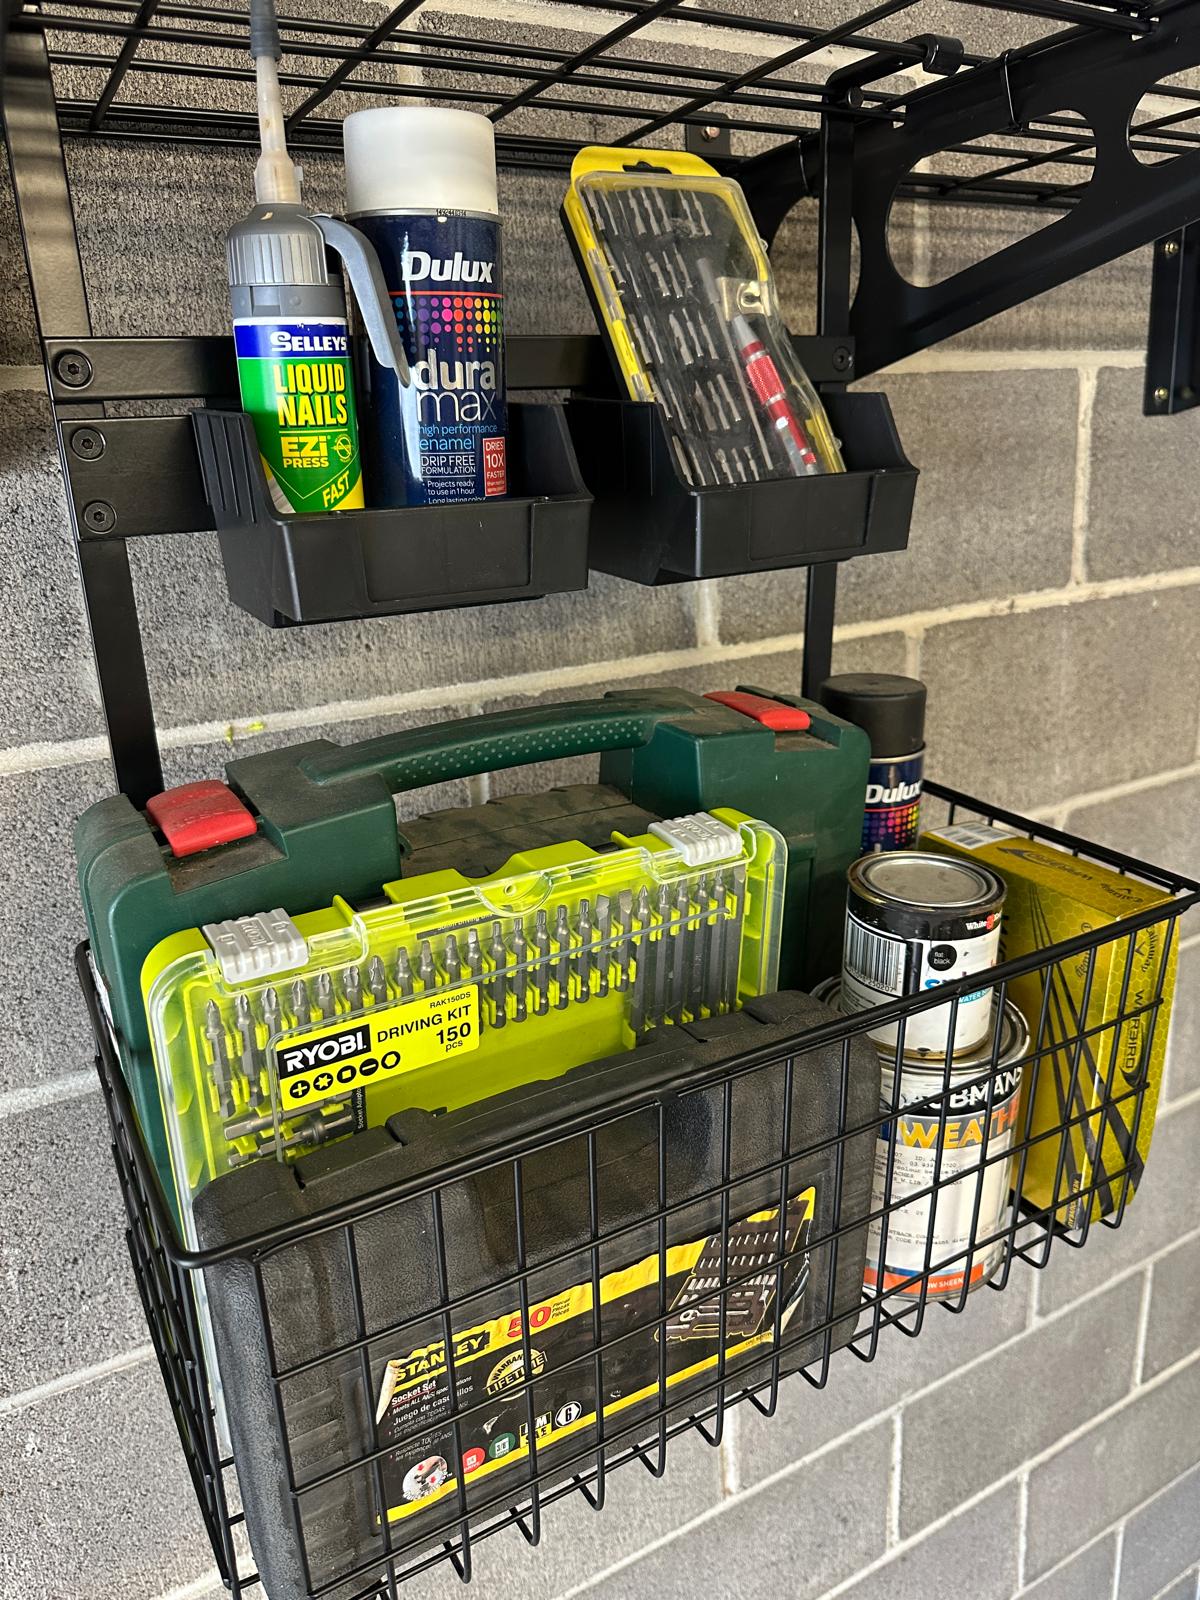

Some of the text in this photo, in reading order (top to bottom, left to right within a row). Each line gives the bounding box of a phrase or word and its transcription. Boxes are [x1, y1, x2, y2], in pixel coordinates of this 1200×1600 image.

[401, 251, 493, 283] Dulux
[270, 331, 347, 351] SELLEYS
[272, 363, 346, 395] LIQUID
[414, 348, 496, 390] dura
[277, 394, 348, 426] NAILS
[416, 391, 496, 421] max
[419, 424, 498, 437] high performance
[419, 434, 475, 450] enamel
[485, 441, 504, 451] DRIES
[283, 457, 329, 468] PRESS
[421, 455, 475, 466] DRIP FREE
[421, 466, 476, 475] FORMULATION
[486, 453, 504, 468] 10X
[427, 479, 475, 489] Projects ready
[486, 470, 505, 479] FASTER
[322, 470, 349, 508] FAST
[865, 780, 922, 803] Dulux
[430, 991, 471, 1009] RAK150DS
[377, 1004, 471, 1043] DRIVING KIT
[436, 1022, 471, 1045] 150
[283, 1031, 365, 1072] RYOBI
[445, 1040, 463, 1052] pcs
[396, 1306, 551, 1382] STANEY 50
[391, 1380, 437, 1406] Socket Set
[410, 1398, 421, 1406] ALL
[393, 1408, 419, 1426] Juego
[420, 1404, 431, 1413] de
